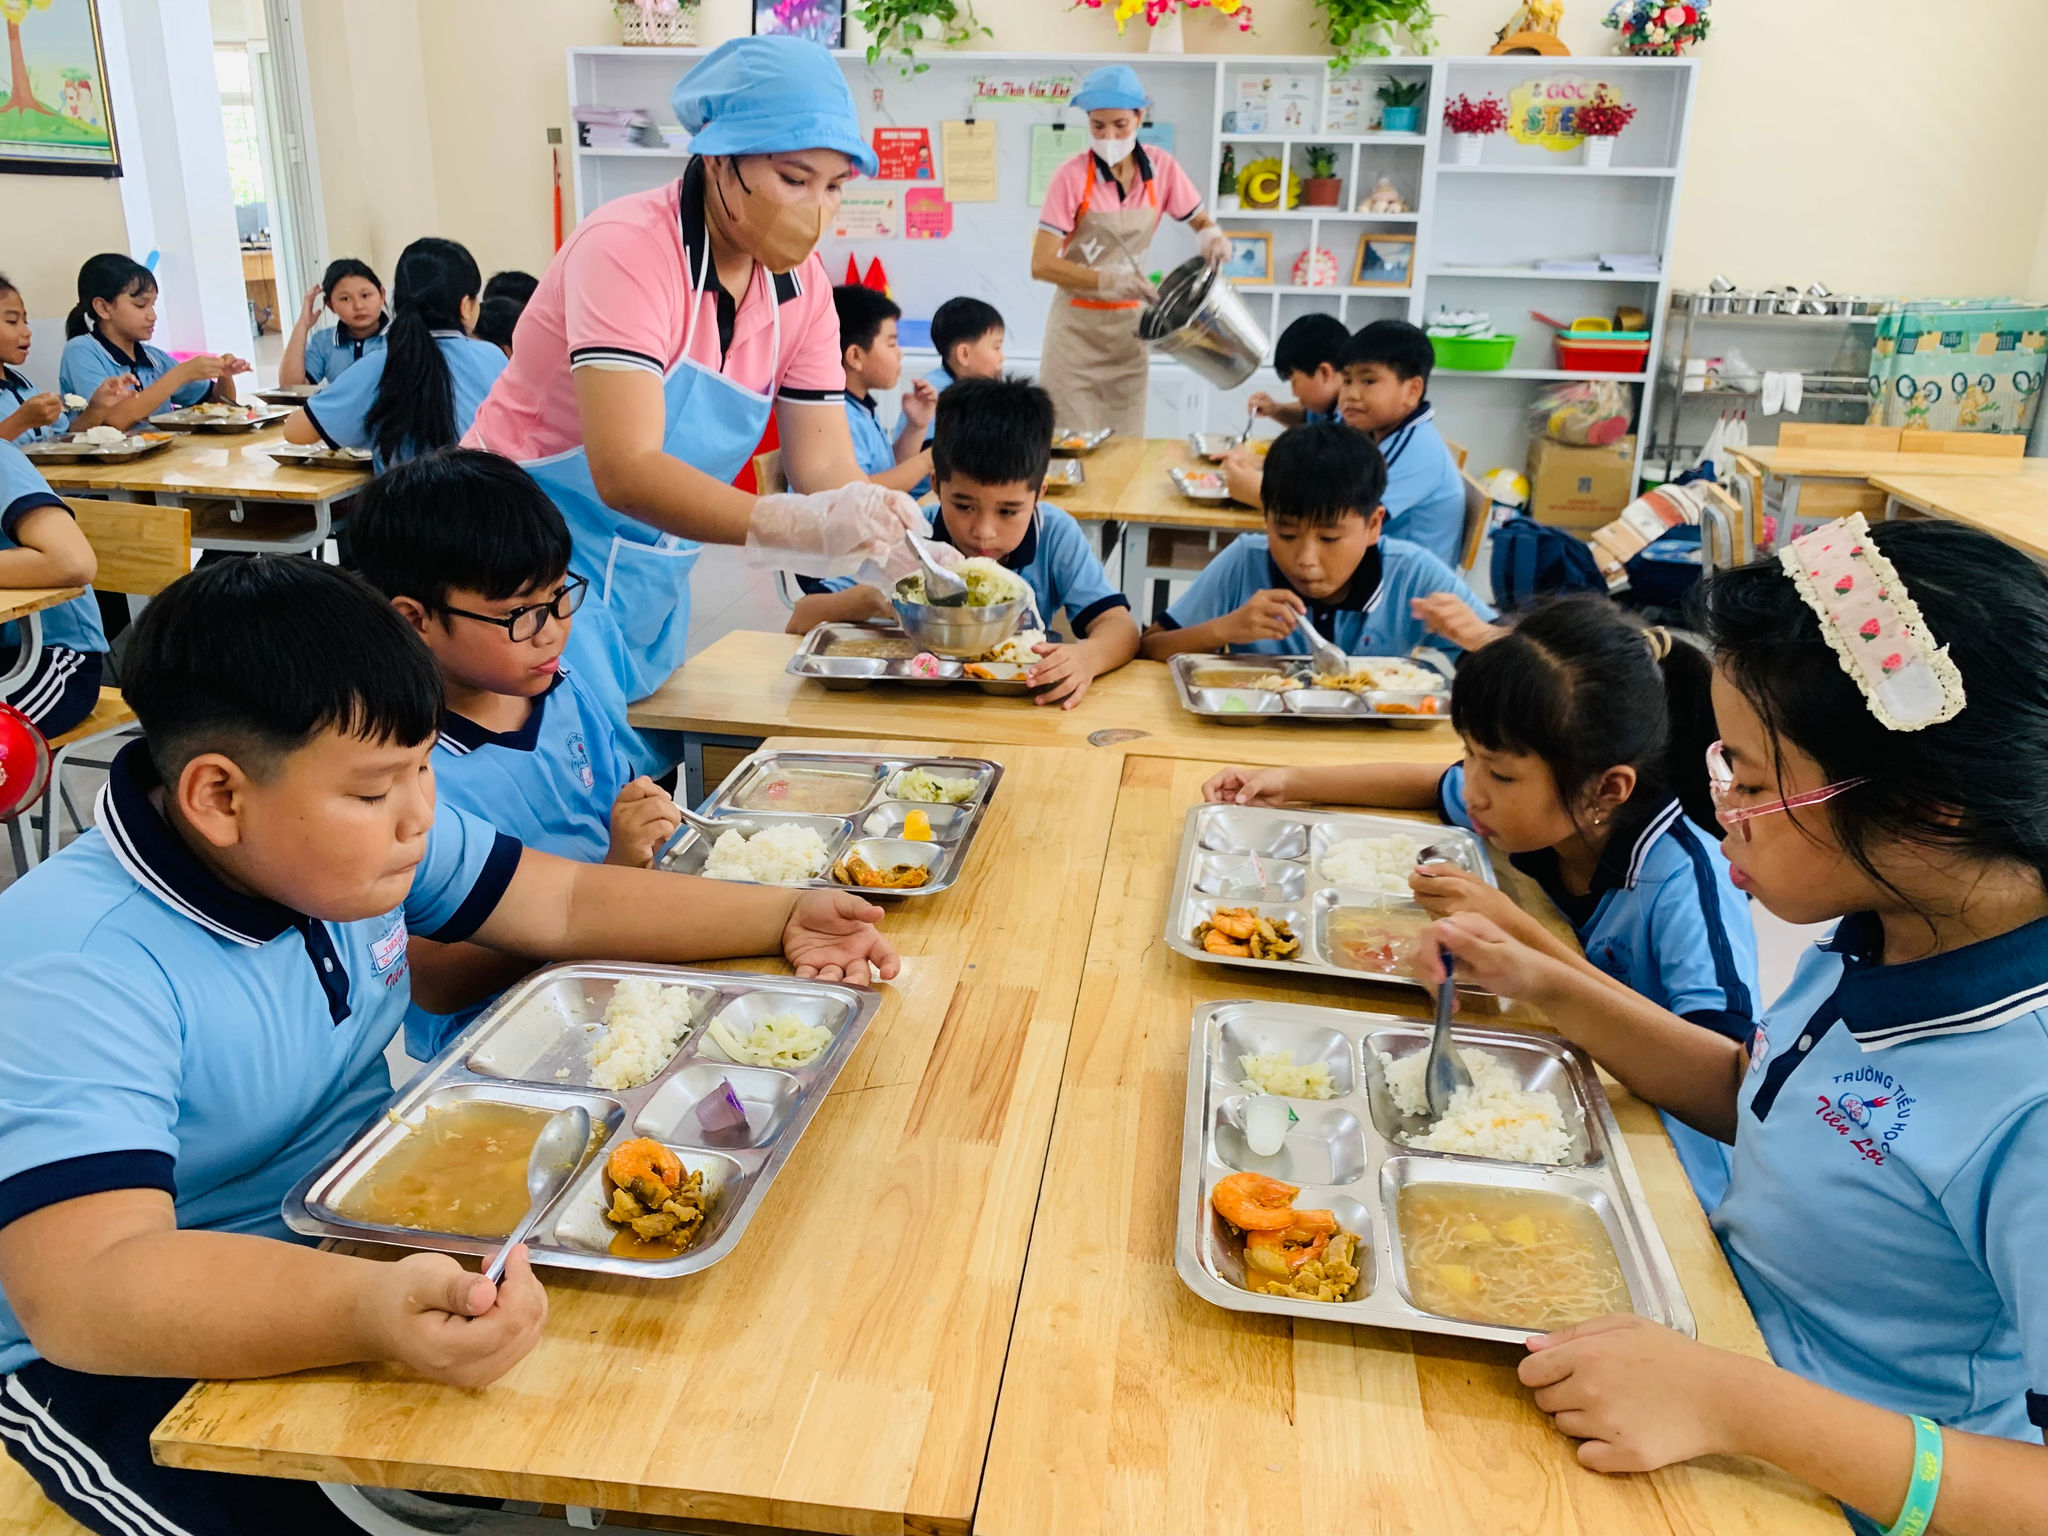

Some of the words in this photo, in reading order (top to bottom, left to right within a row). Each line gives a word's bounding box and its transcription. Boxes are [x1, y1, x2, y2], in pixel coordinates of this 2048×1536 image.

[1546, 80, 1588, 99] GÓC
[1526, 105, 1578, 134] STE
[1833, 1065, 1893, 1090] TRƯỜNG
[1893, 1085, 1916, 1118] TIỂU
[1816, 1095, 1850, 1135] Tiến
[1850, 1138, 1886, 1166] Lợi
[1881, 1123, 1907, 1154] HỌC
